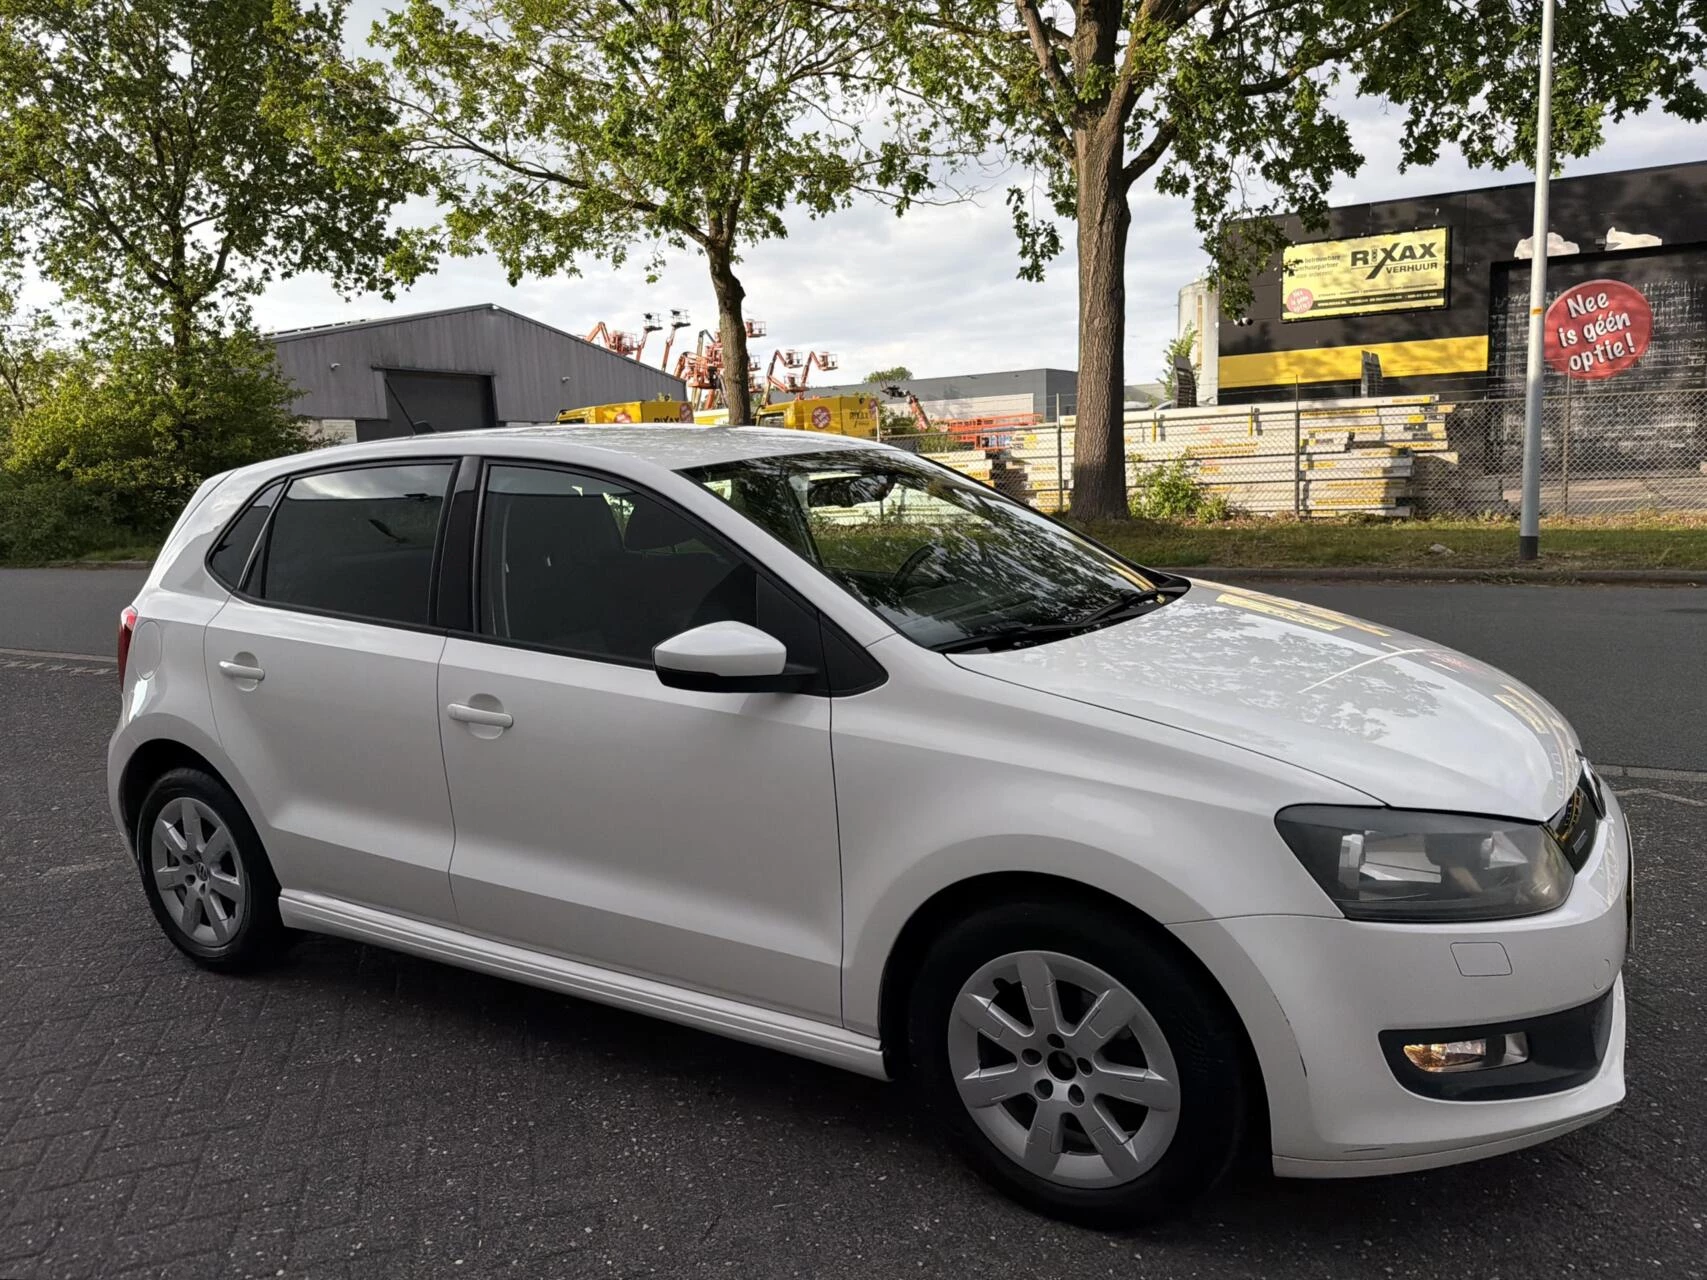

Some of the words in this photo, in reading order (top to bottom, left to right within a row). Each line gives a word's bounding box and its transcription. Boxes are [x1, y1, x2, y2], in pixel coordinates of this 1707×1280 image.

[1386, 262, 1438, 274] VERHUUR
[1567, 293, 1609, 318] Nee
[1558, 327, 1578, 347] is
[1583, 310, 1631, 342] géén
[1569, 333, 1636, 371] optie!
